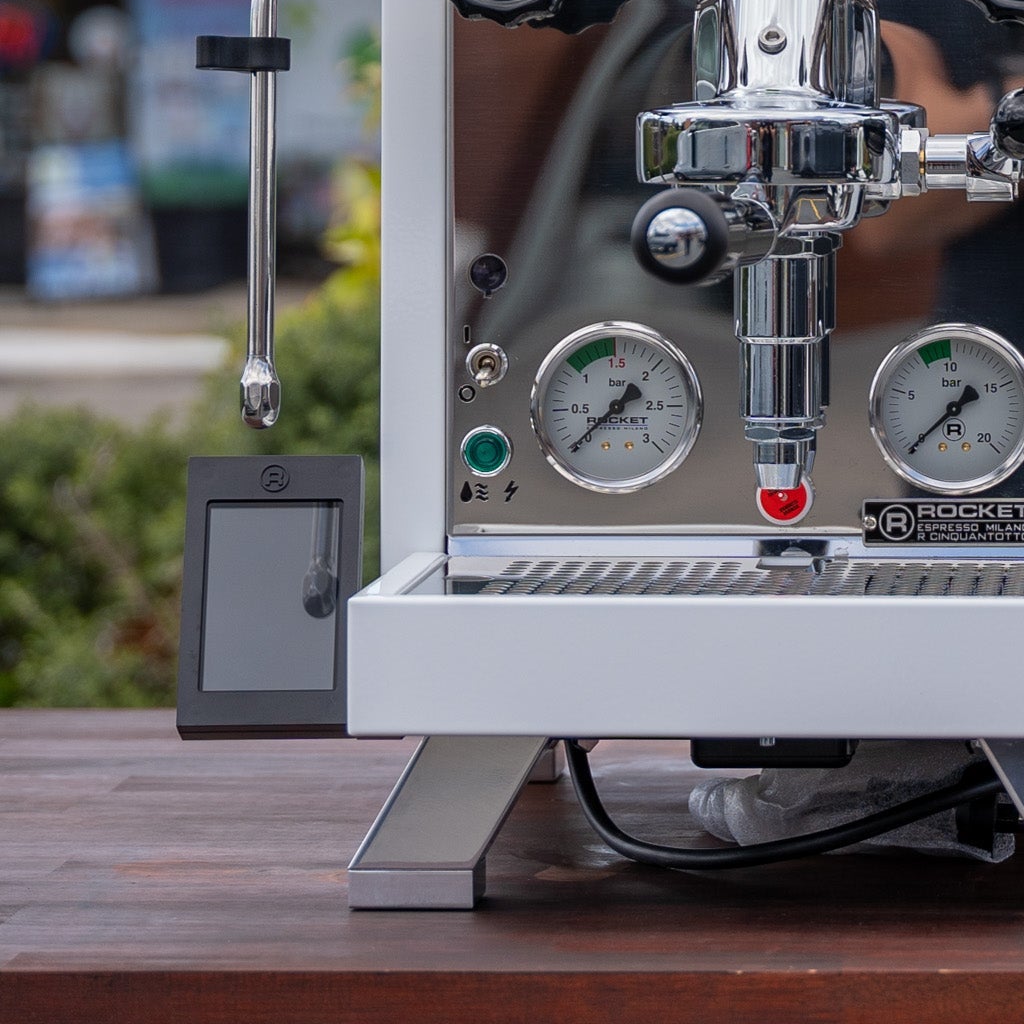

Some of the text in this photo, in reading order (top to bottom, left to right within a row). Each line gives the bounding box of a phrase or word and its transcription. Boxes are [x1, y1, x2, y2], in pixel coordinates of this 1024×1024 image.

[608, 358, 626, 368] 1.5
[944, 362, 957, 372] 10
[583, 374, 588, 383] 1
[642, 371, 650, 381] 2
[609, 378, 626, 387] bar
[942, 378, 961, 387] bar
[984, 383, 998, 393] 15
[908, 390, 915, 400] 5
[571, 404, 590, 414] 0.5
[646, 400, 664, 411] 2.5
[946, 423, 962, 436] R
[643, 433, 650, 443] 3
[977, 433, 991, 443] 20
[886, 513, 907, 533] R
[917, 523, 979, 532] ESPRESSO
[917, 533, 926, 541] R
